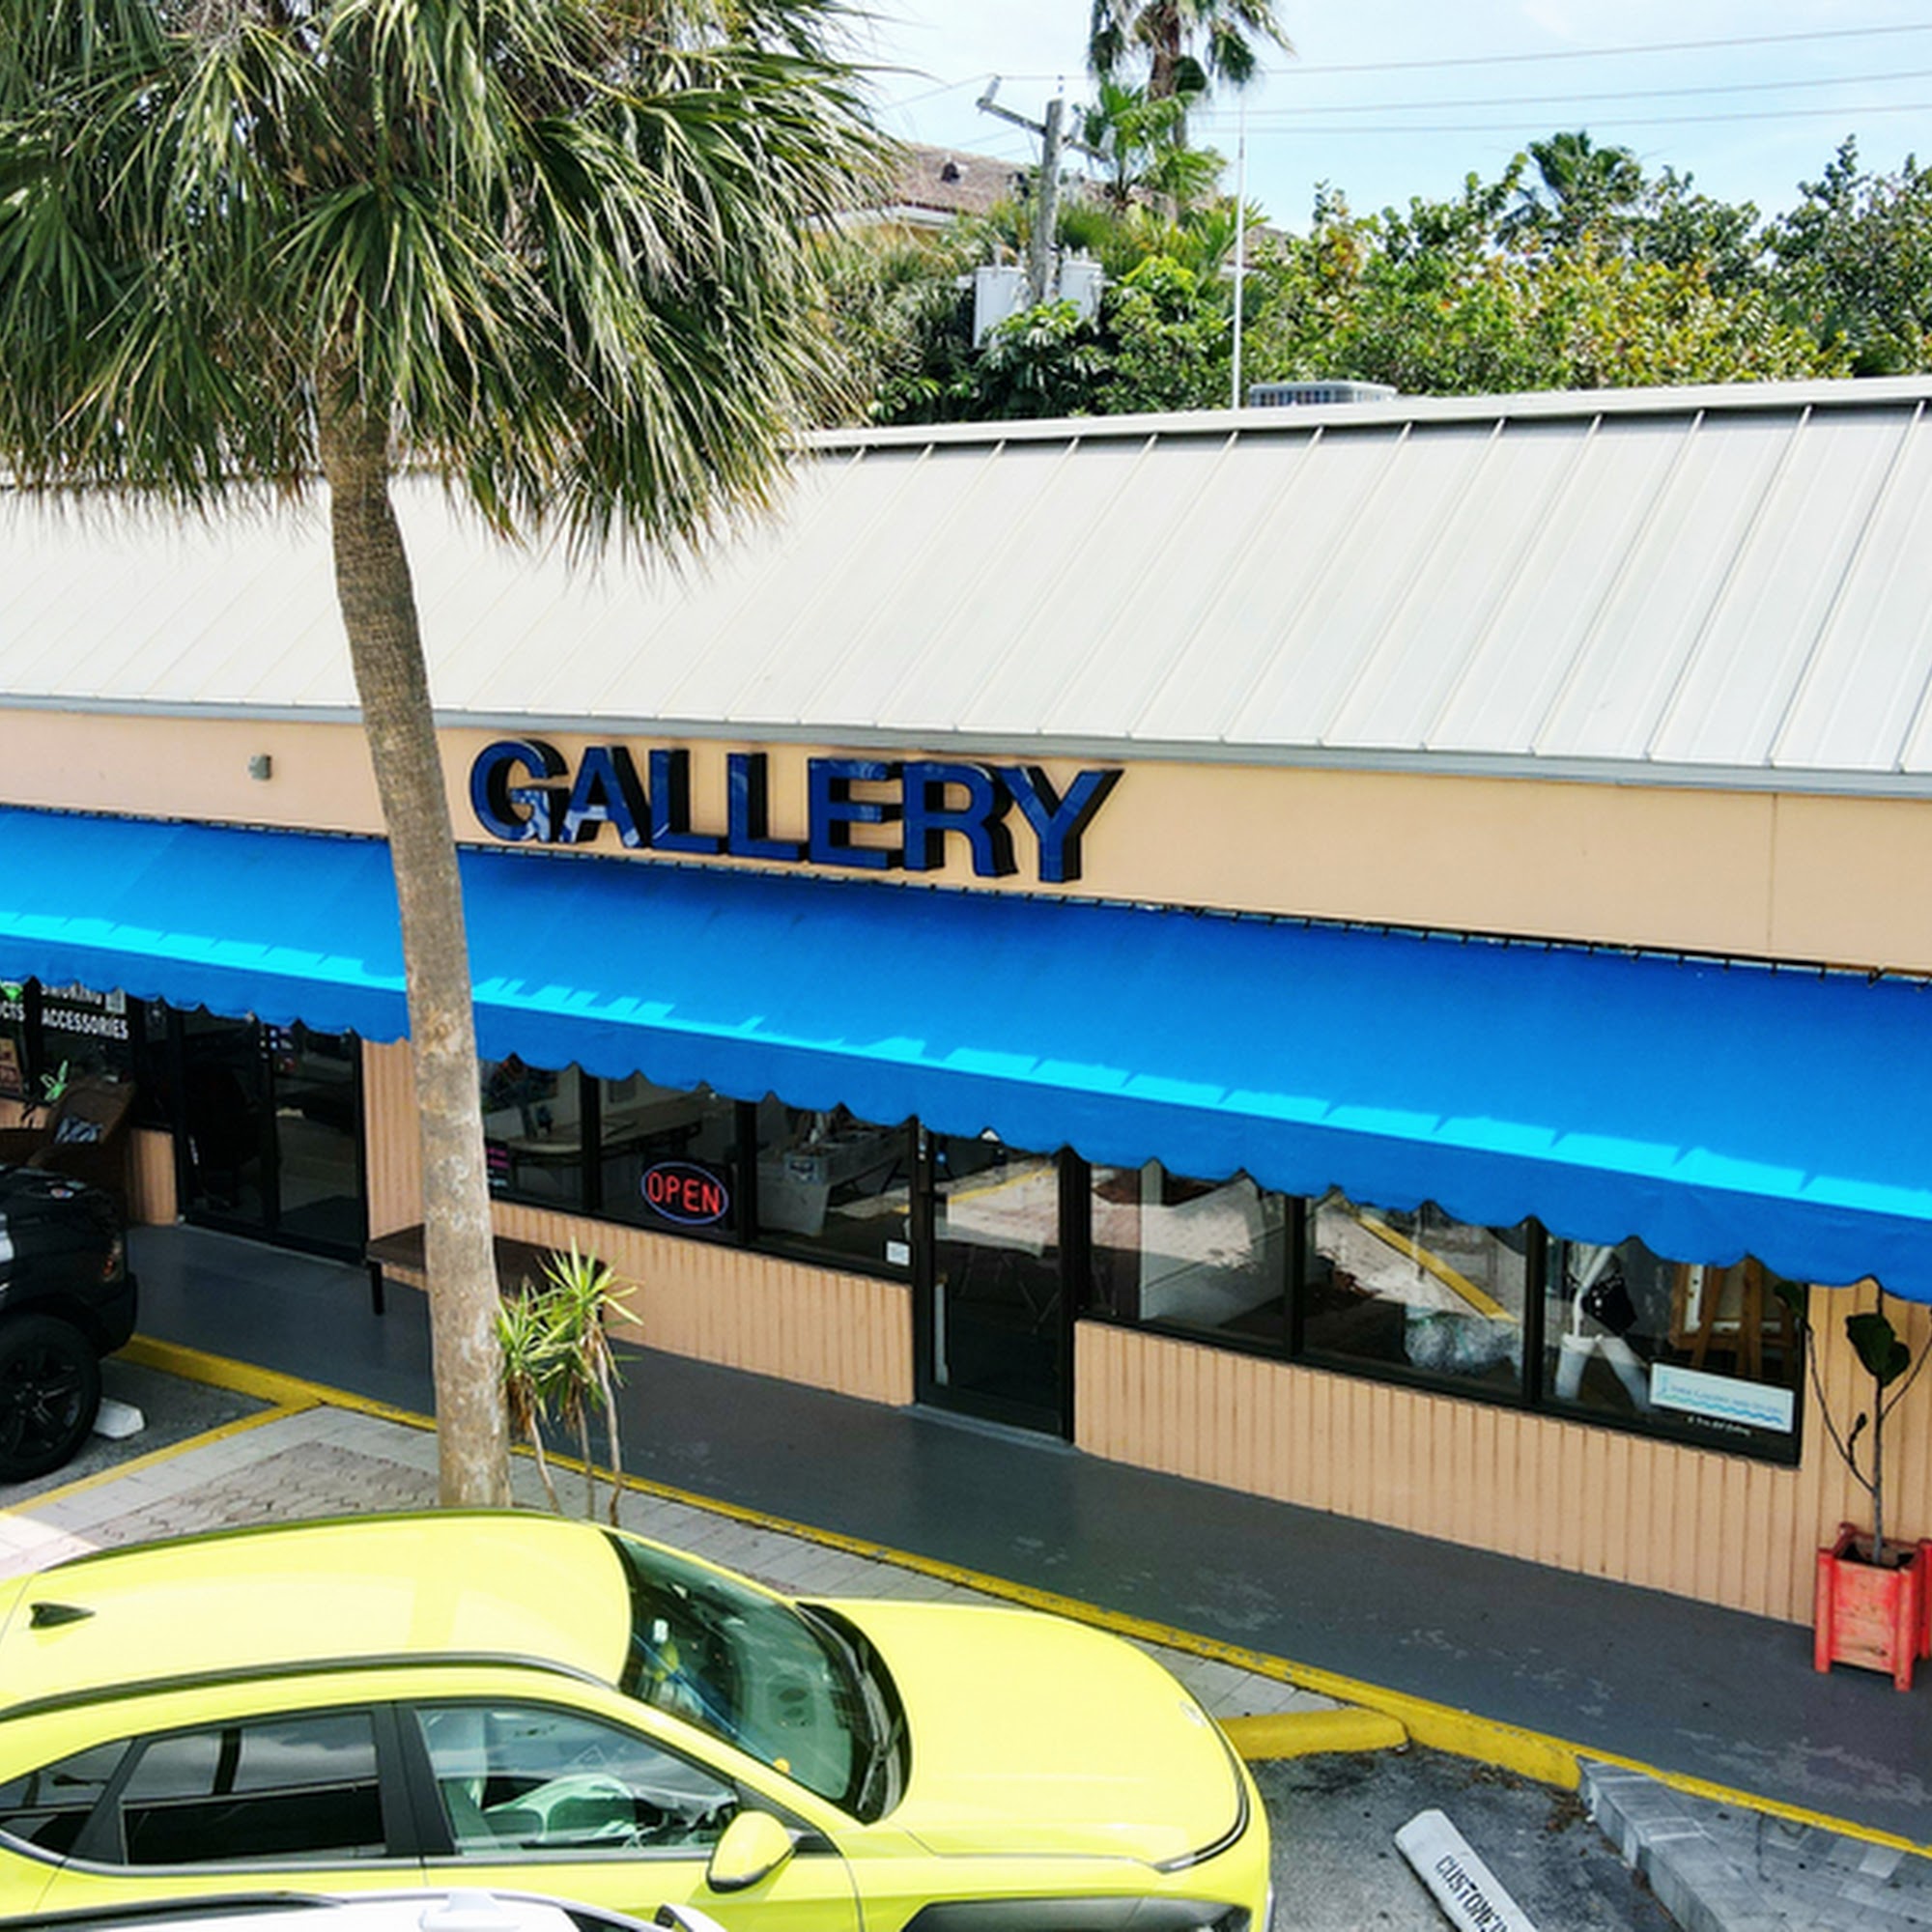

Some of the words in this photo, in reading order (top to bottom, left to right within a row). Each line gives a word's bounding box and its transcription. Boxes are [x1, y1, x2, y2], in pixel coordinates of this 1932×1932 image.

[469, 737, 1124, 883] GALLERY
[42, 1009, 128, 1040] ACCESSORIES
[647, 1171, 721, 1215] OPEN
